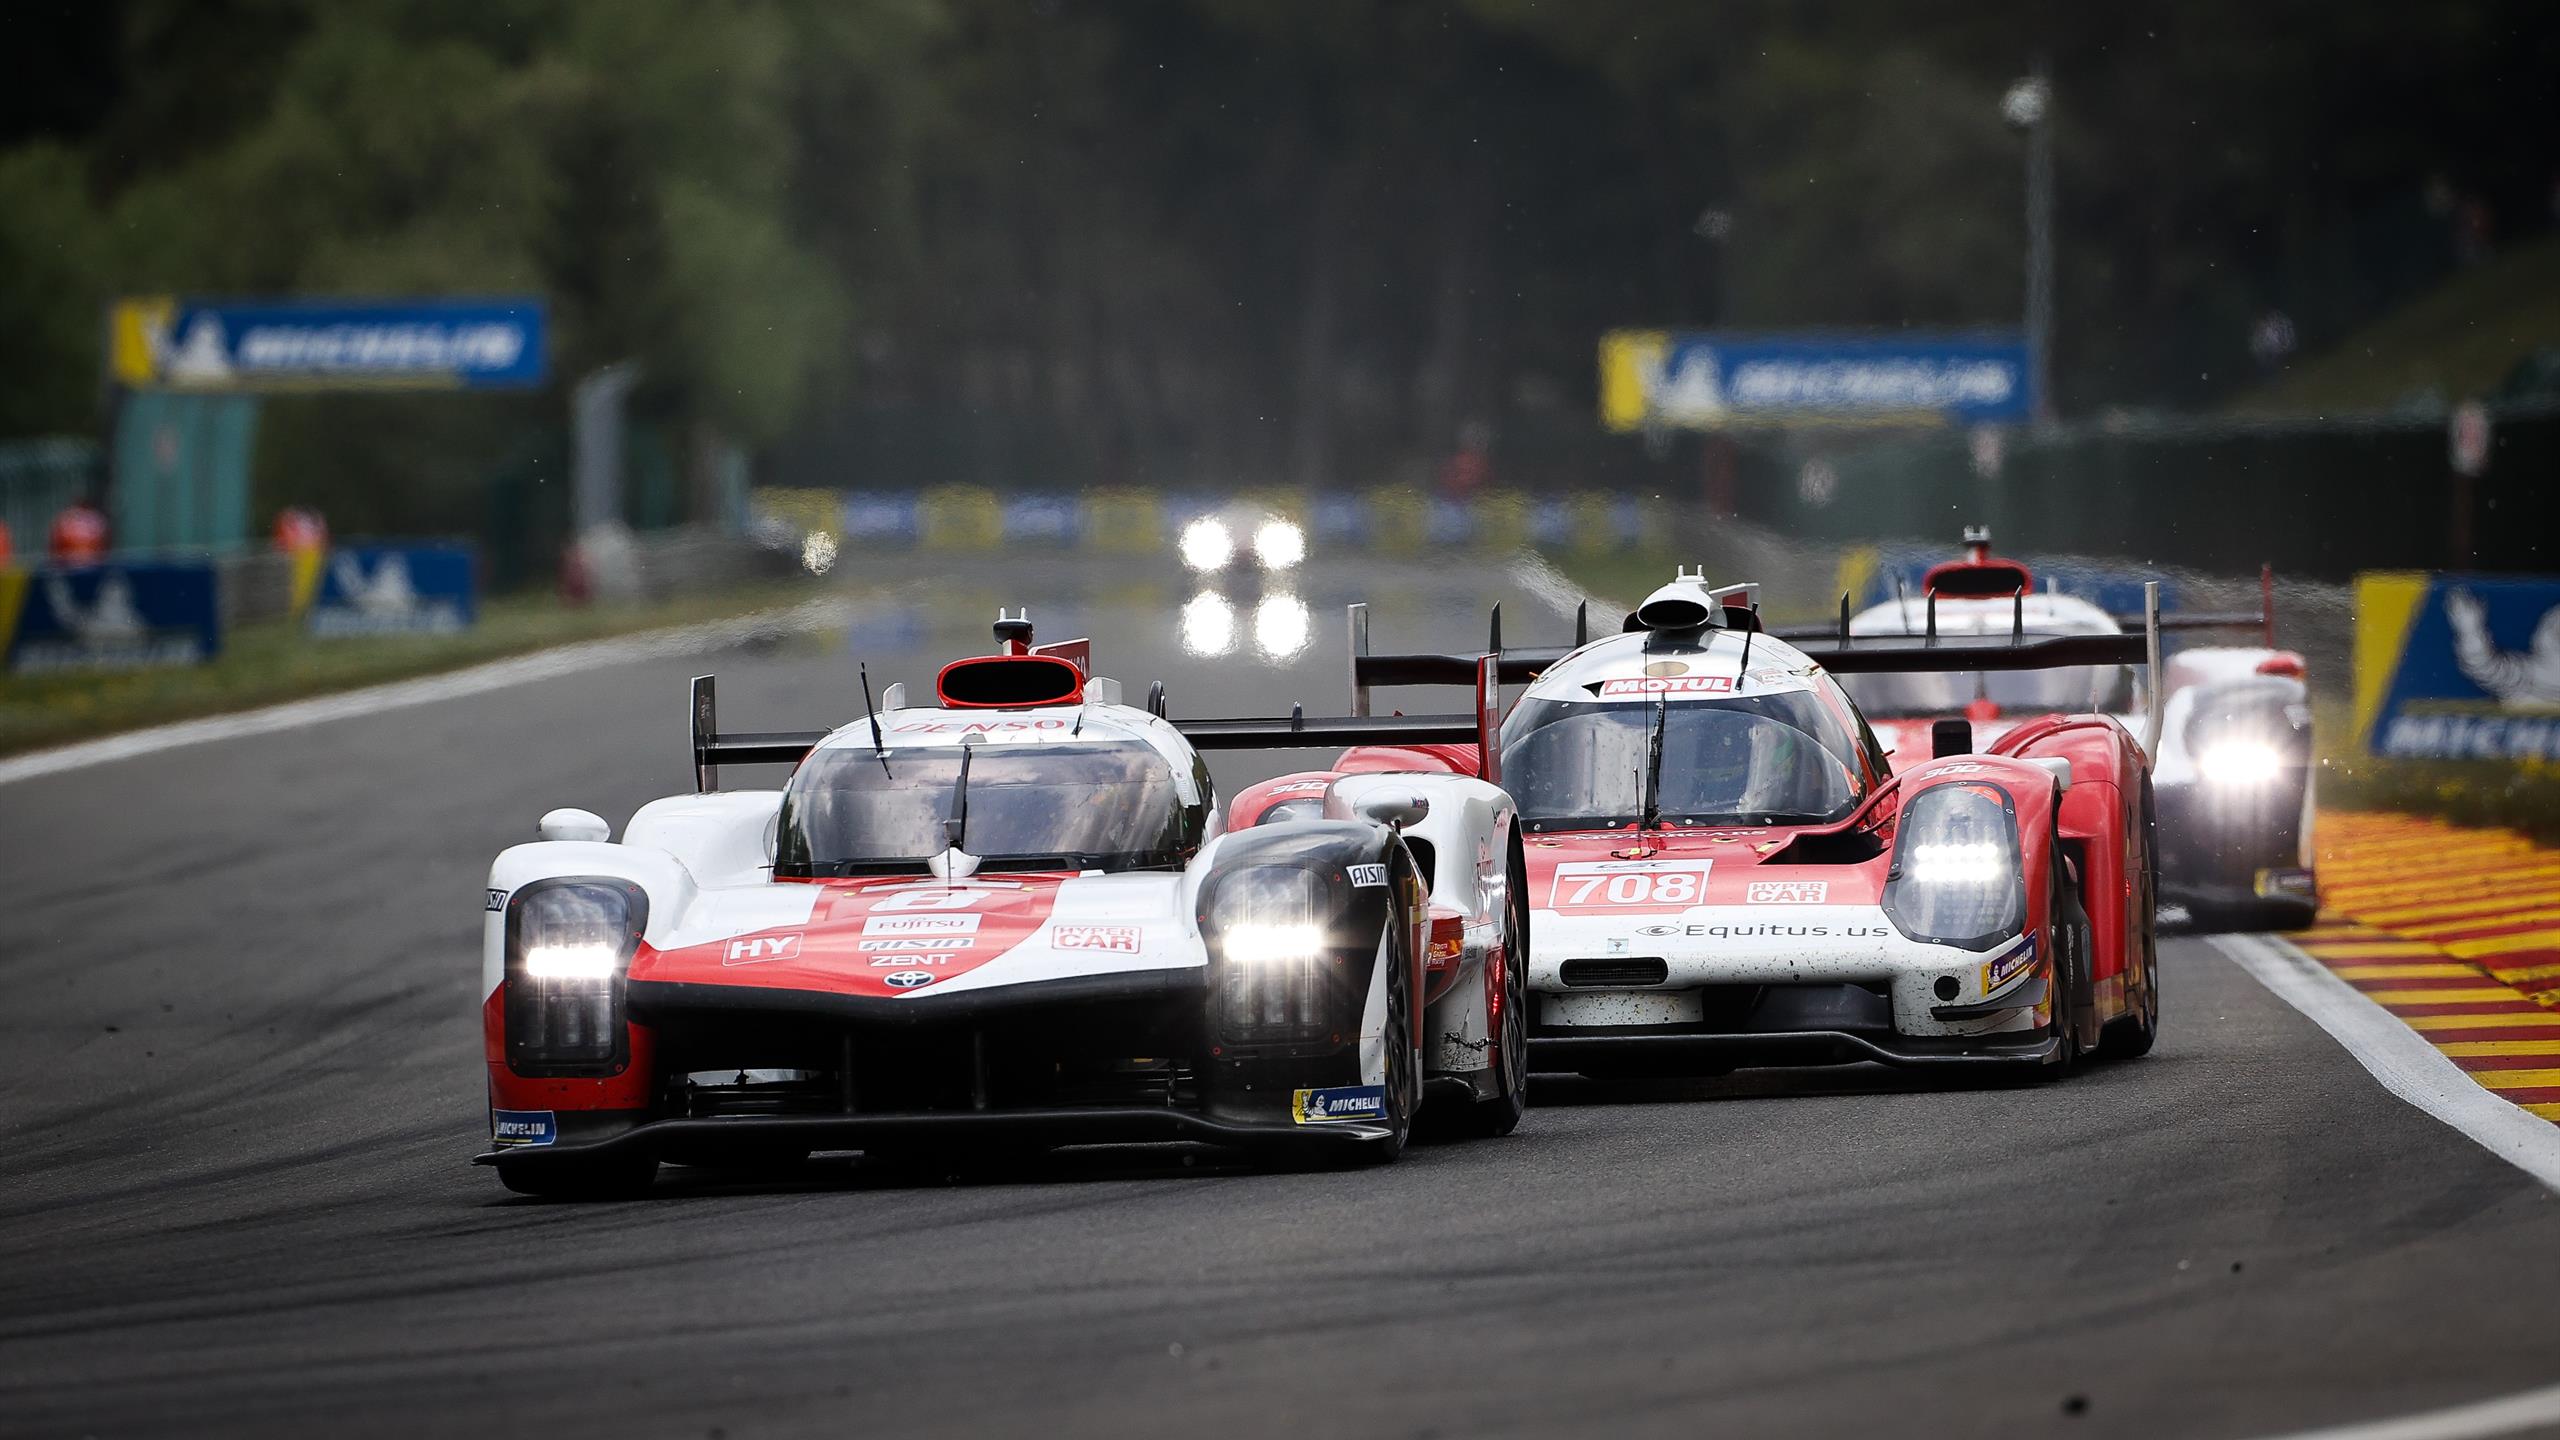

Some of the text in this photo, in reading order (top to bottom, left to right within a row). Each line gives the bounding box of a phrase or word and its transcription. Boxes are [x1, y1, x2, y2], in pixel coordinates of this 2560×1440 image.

[1605, 678, 1731, 692] MOTUL
[893, 718, 1065, 732] DENSO
[2383, 717, 2560, 756] MICH
[1563, 873, 1697, 904] 708
[1751, 890, 1821, 902] CAR
[878, 917, 965, 930] FUJITSU
[1059, 927, 1135, 936] HYPER
[1686, 923, 1889, 939] Equitus.us
[729, 935, 797, 960] HY
[1058, 934, 1133, 951] CAR
[870, 953, 956, 967] ZENT
[2000, 944, 2034, 977] MICHELIN
[1328, 1096, 1381, 1112] MICHELIN
